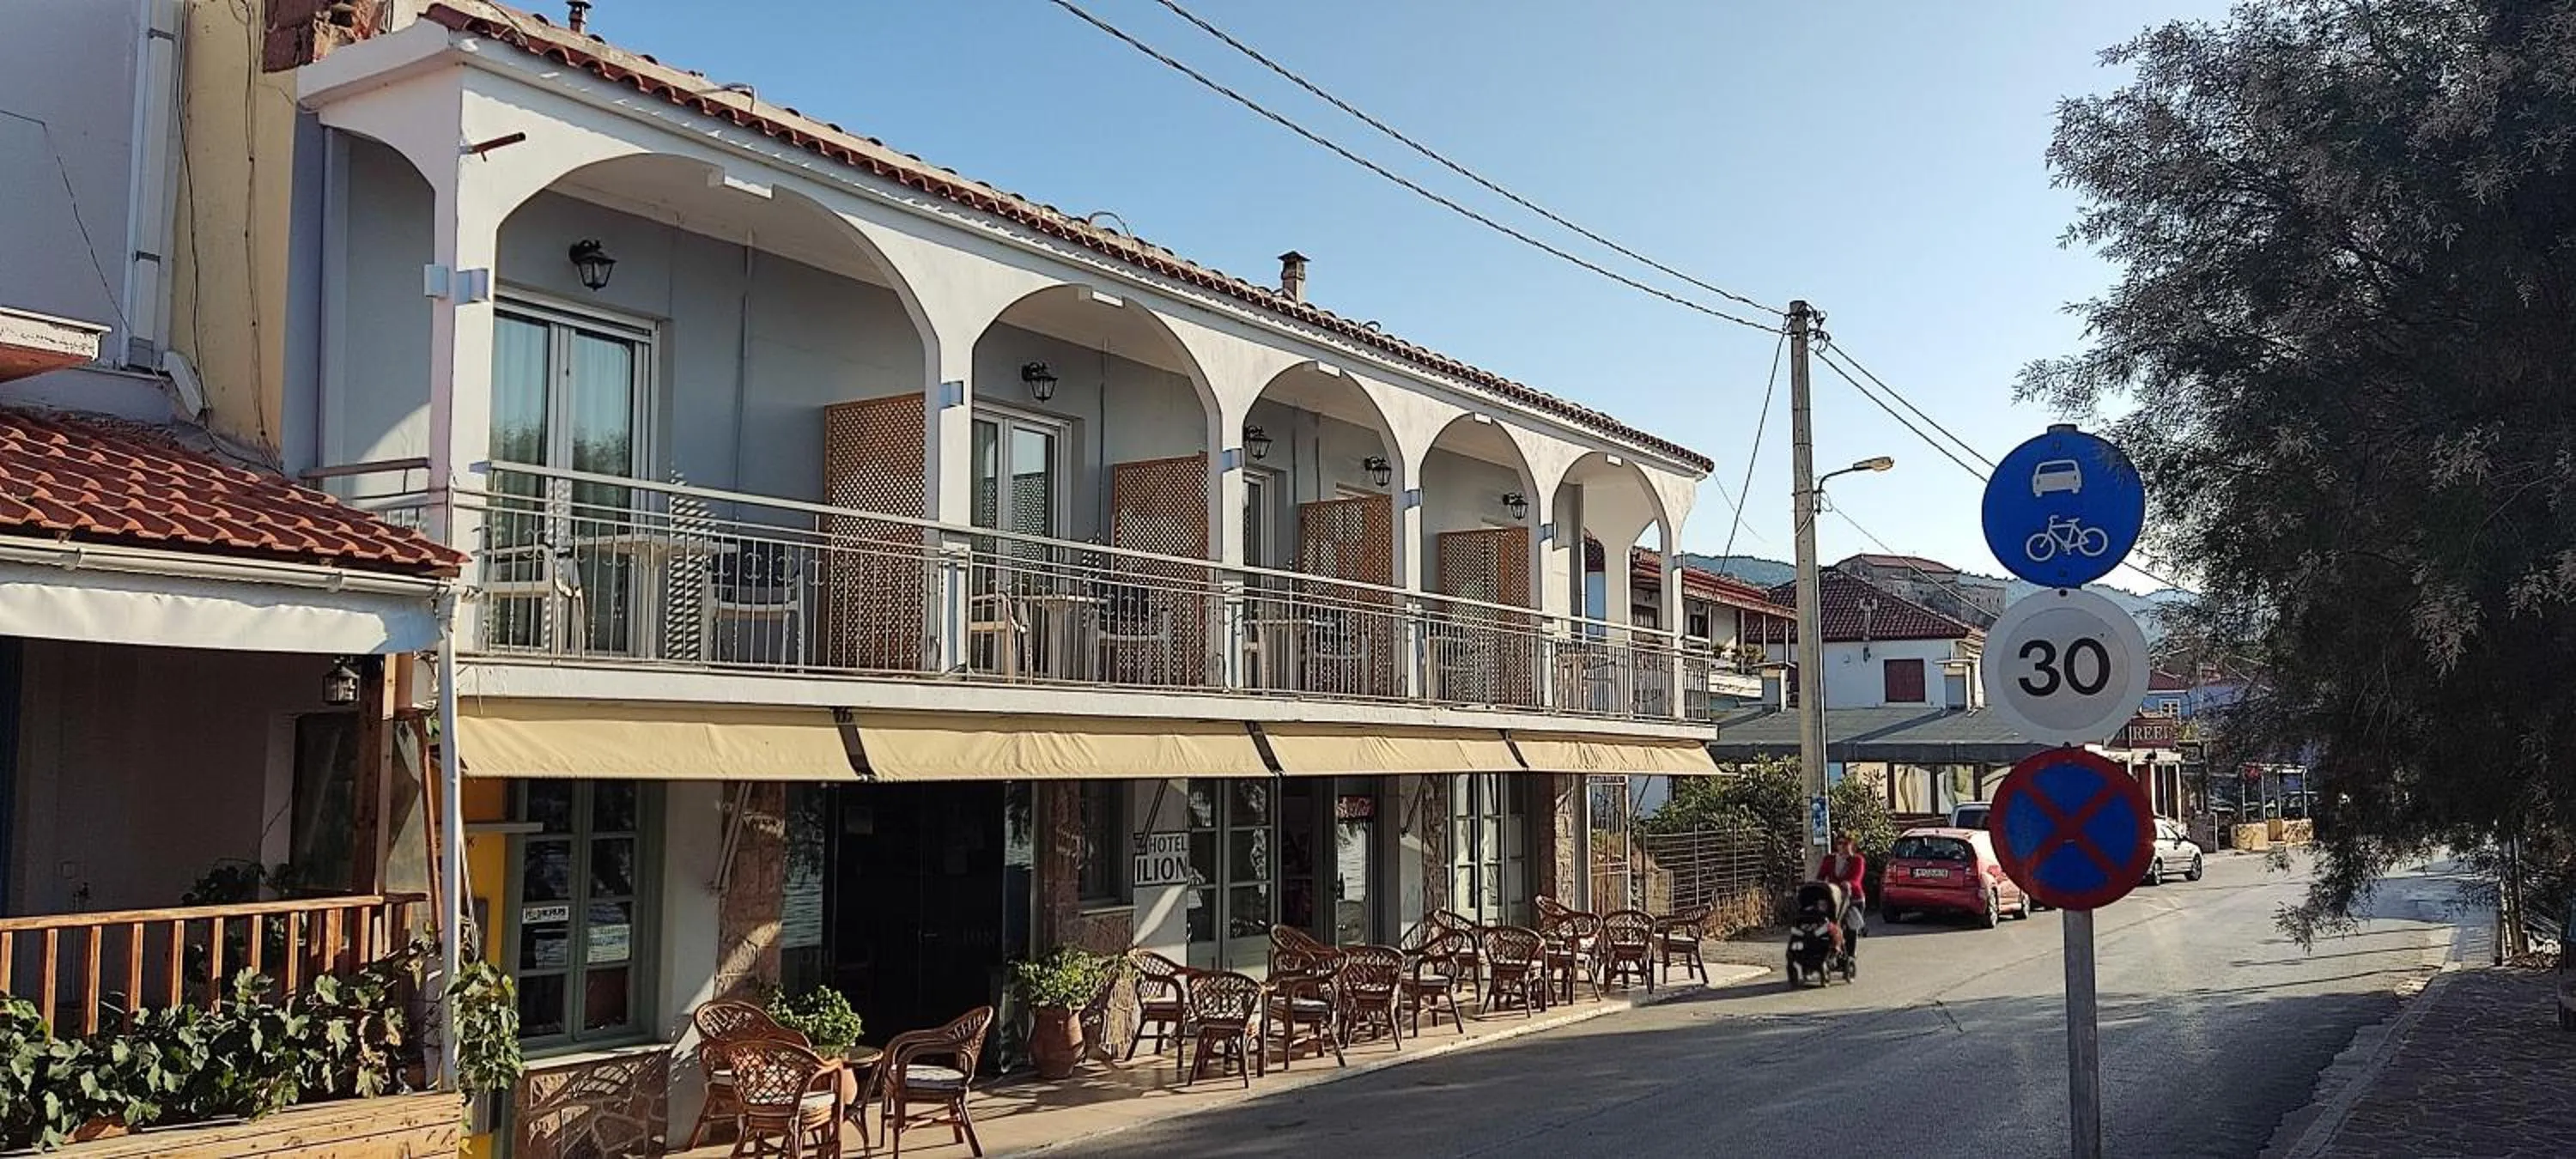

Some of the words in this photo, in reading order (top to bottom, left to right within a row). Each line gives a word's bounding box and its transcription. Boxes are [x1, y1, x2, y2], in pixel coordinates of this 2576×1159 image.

[2019, 638, 2111, 696] 30
[1149, 836, 1189, 853] HOTEL
[1136, 857, 1188, 882] ILION
